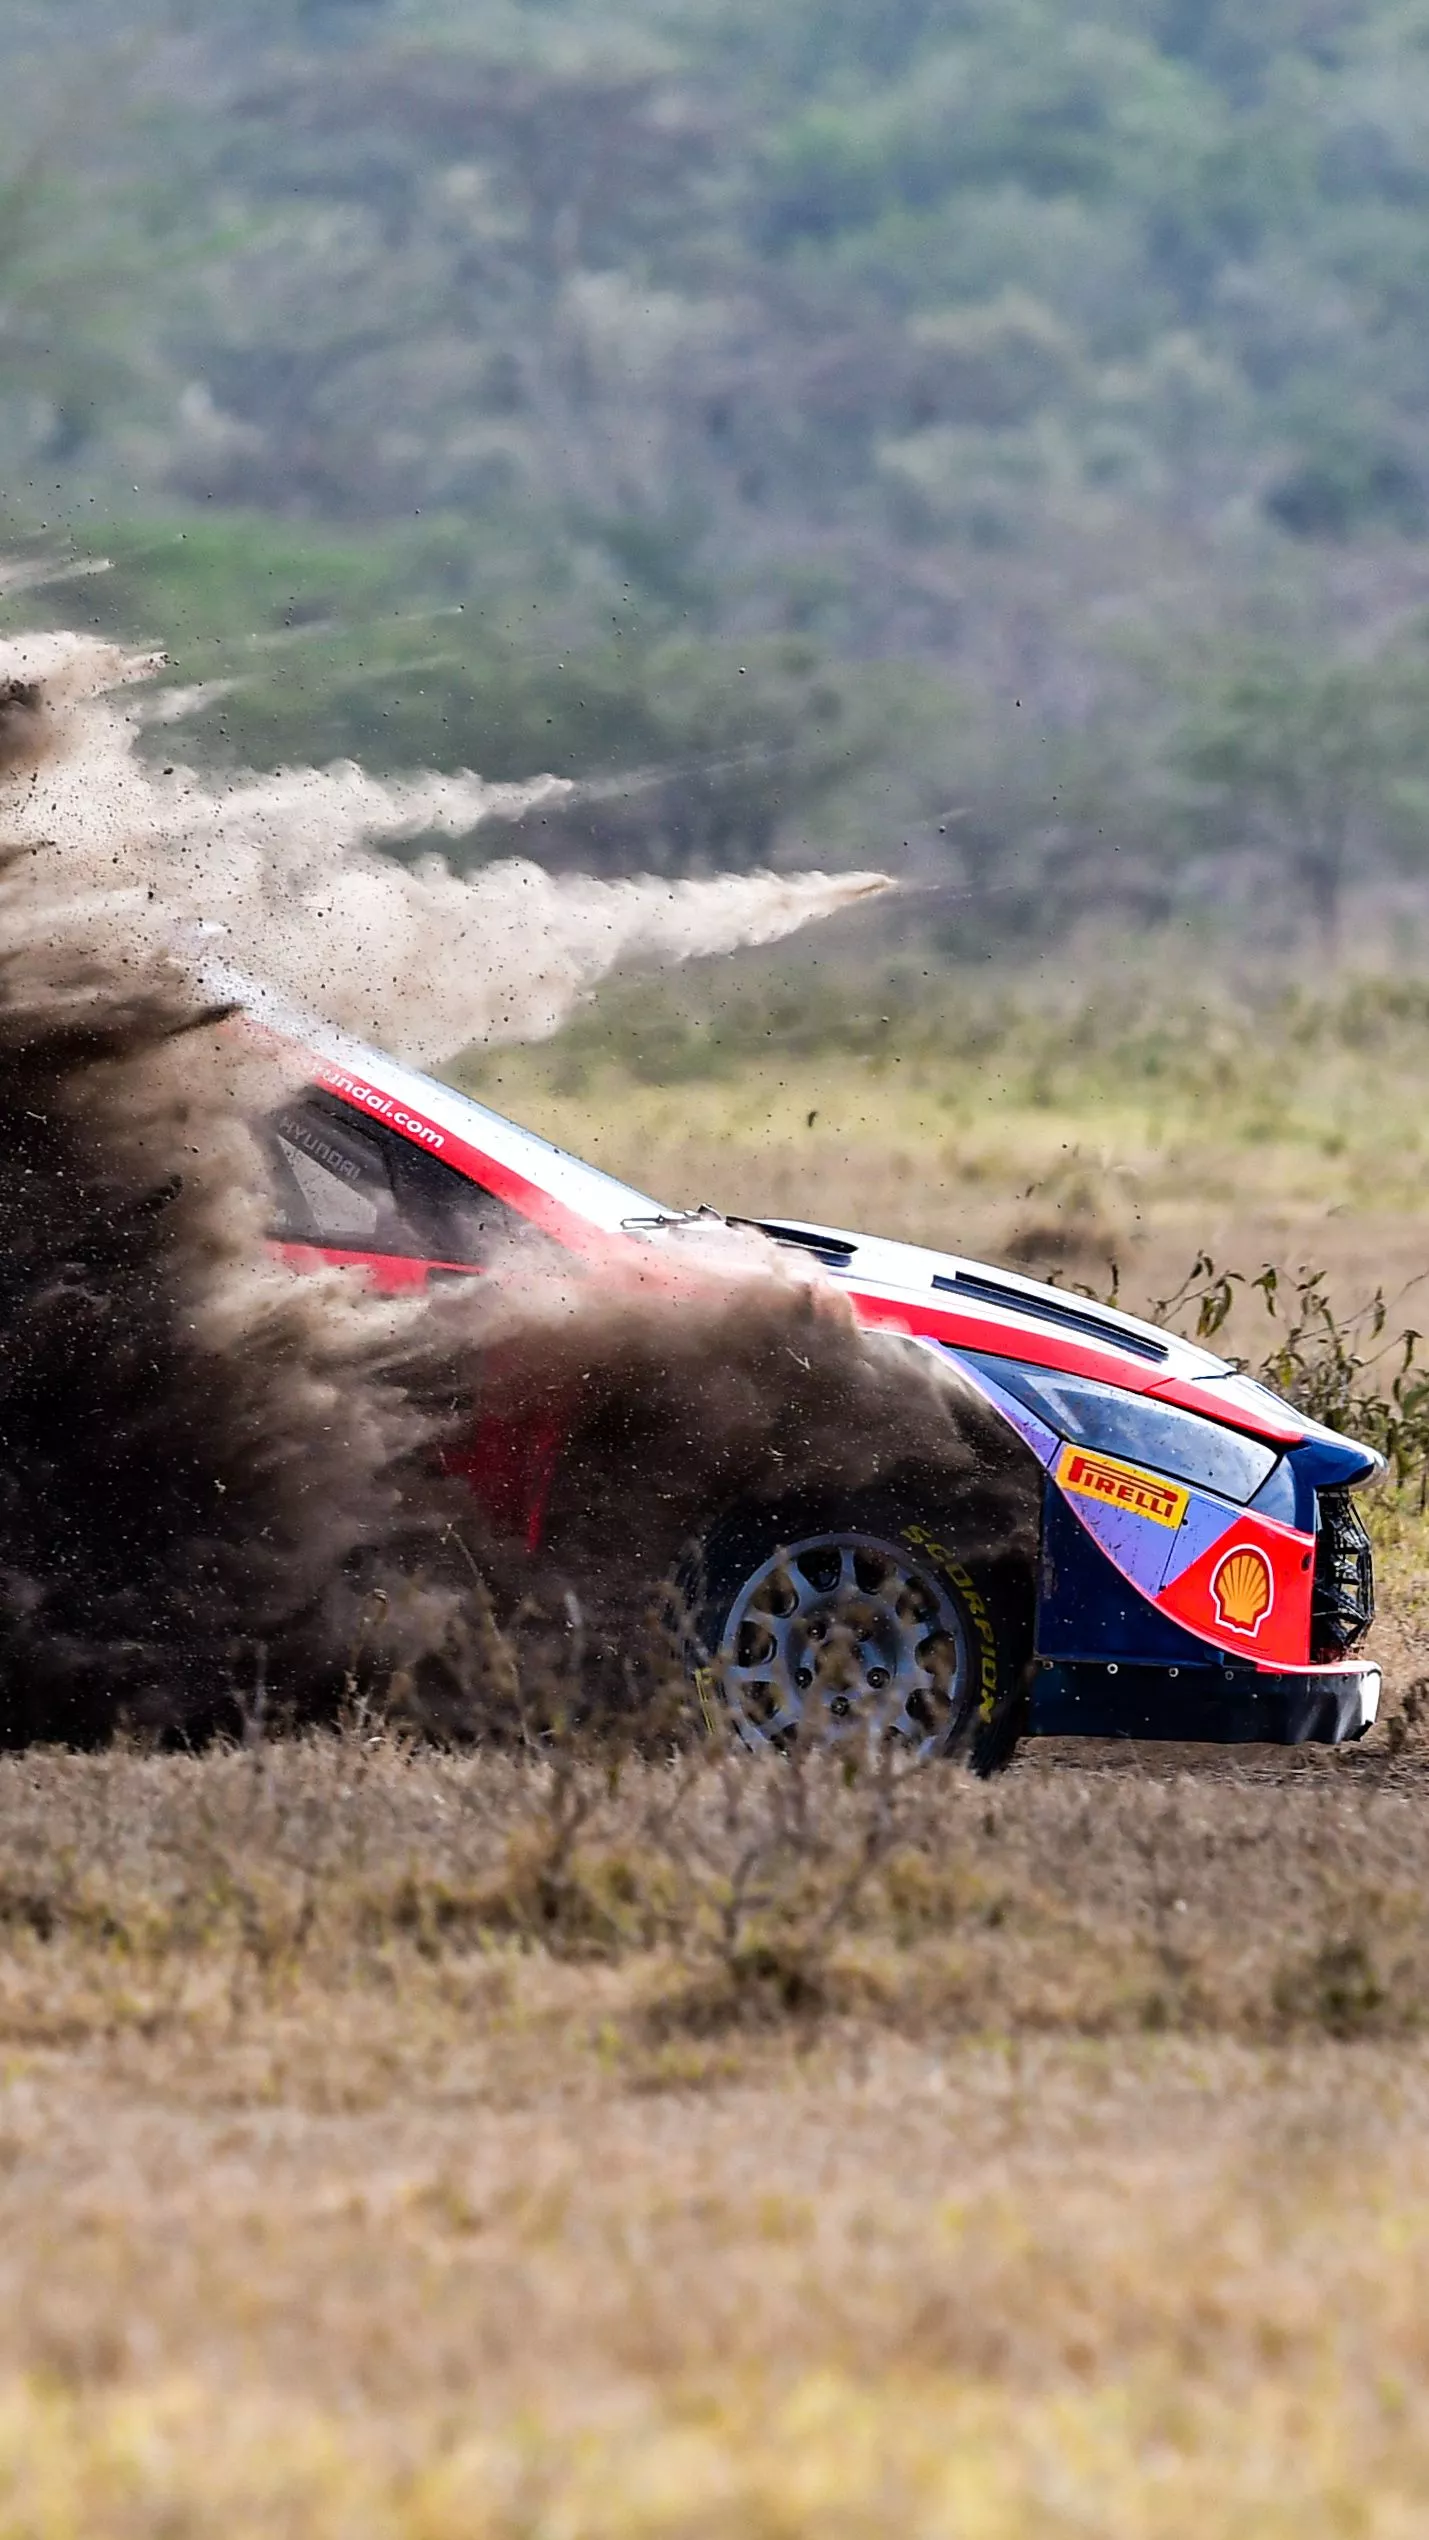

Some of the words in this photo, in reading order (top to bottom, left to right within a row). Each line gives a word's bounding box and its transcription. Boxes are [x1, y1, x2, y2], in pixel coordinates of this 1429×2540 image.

[309, 1063, 445, 1148] undai.com
[280, 1116, 361, 1180] HYUNDAI
[1068, 1455, 1179, 1518] PIRELLI
